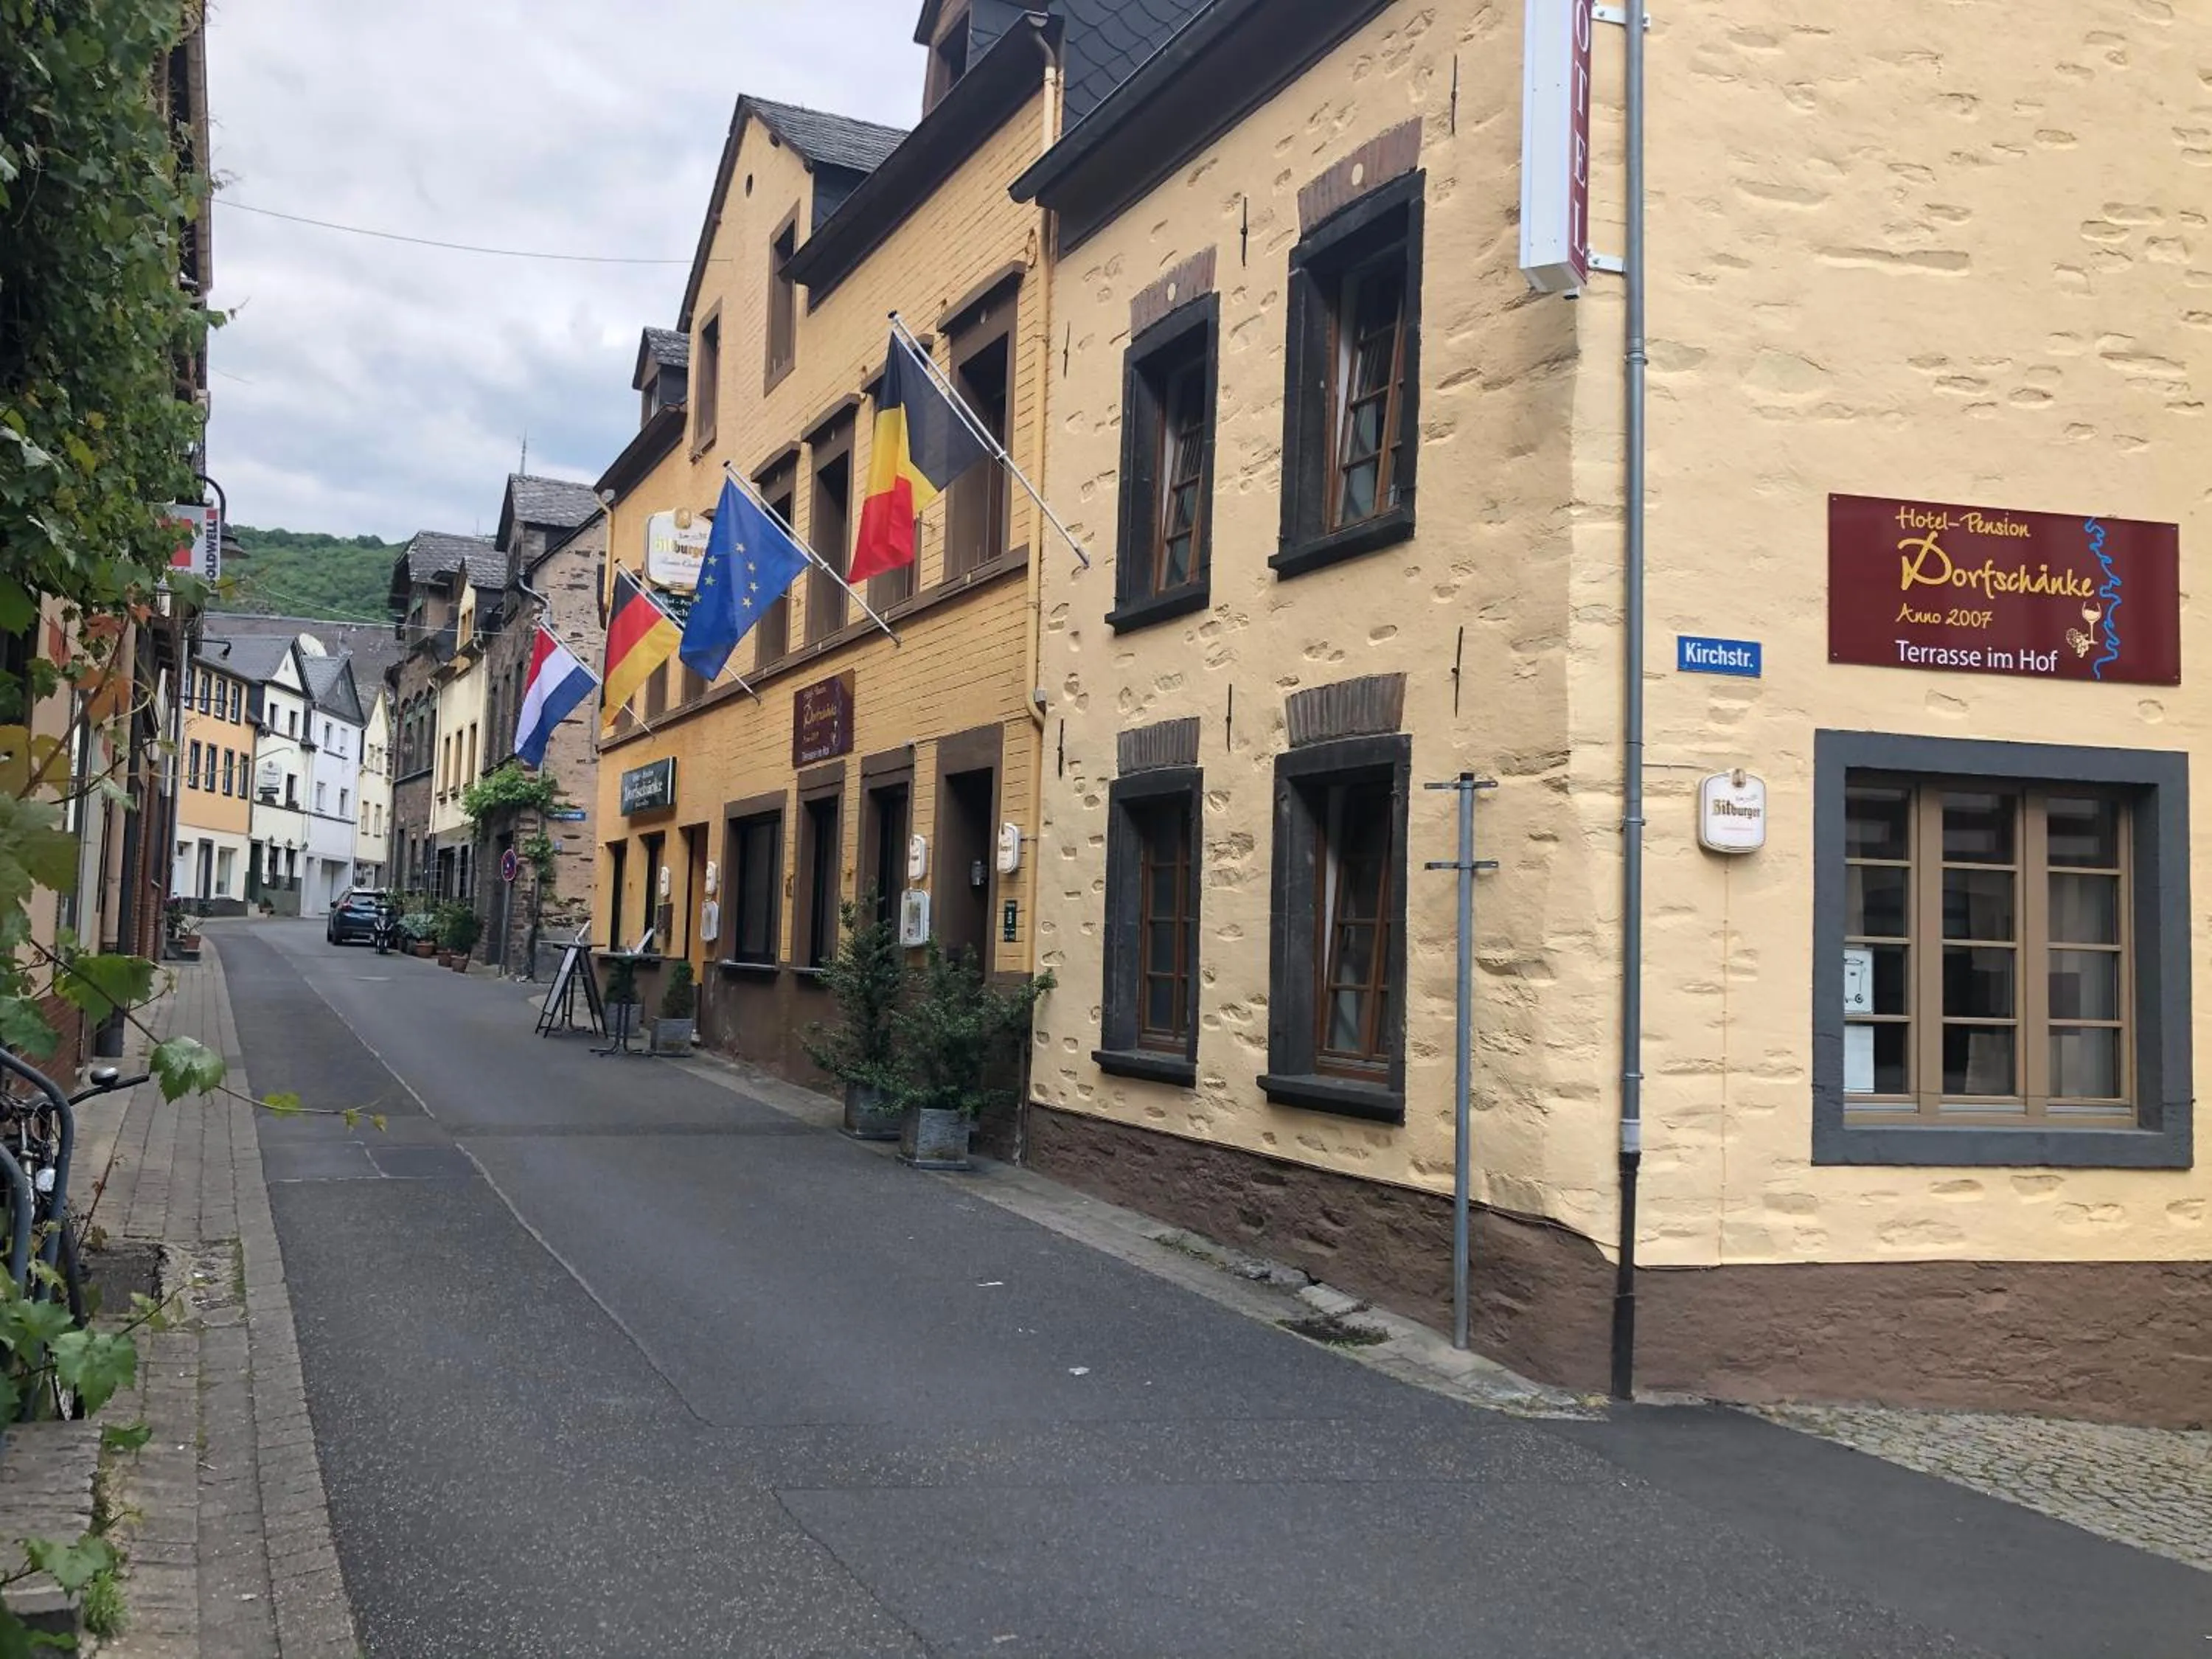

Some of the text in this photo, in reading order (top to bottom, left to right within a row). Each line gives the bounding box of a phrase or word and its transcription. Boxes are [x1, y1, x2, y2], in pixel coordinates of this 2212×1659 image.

[1896, 505, 2031, 537] Hotel-Pension
[1897, 531, 2094, 599] Dorfschänke
[1895, 602, 1993, 628] Anno 2007
[1686, 642, 1754, 667] Kirchstr.
[1895, 639, 2059, 672] Terrasse im Hof
[1711, 799, 1761, 818] Bitburger
